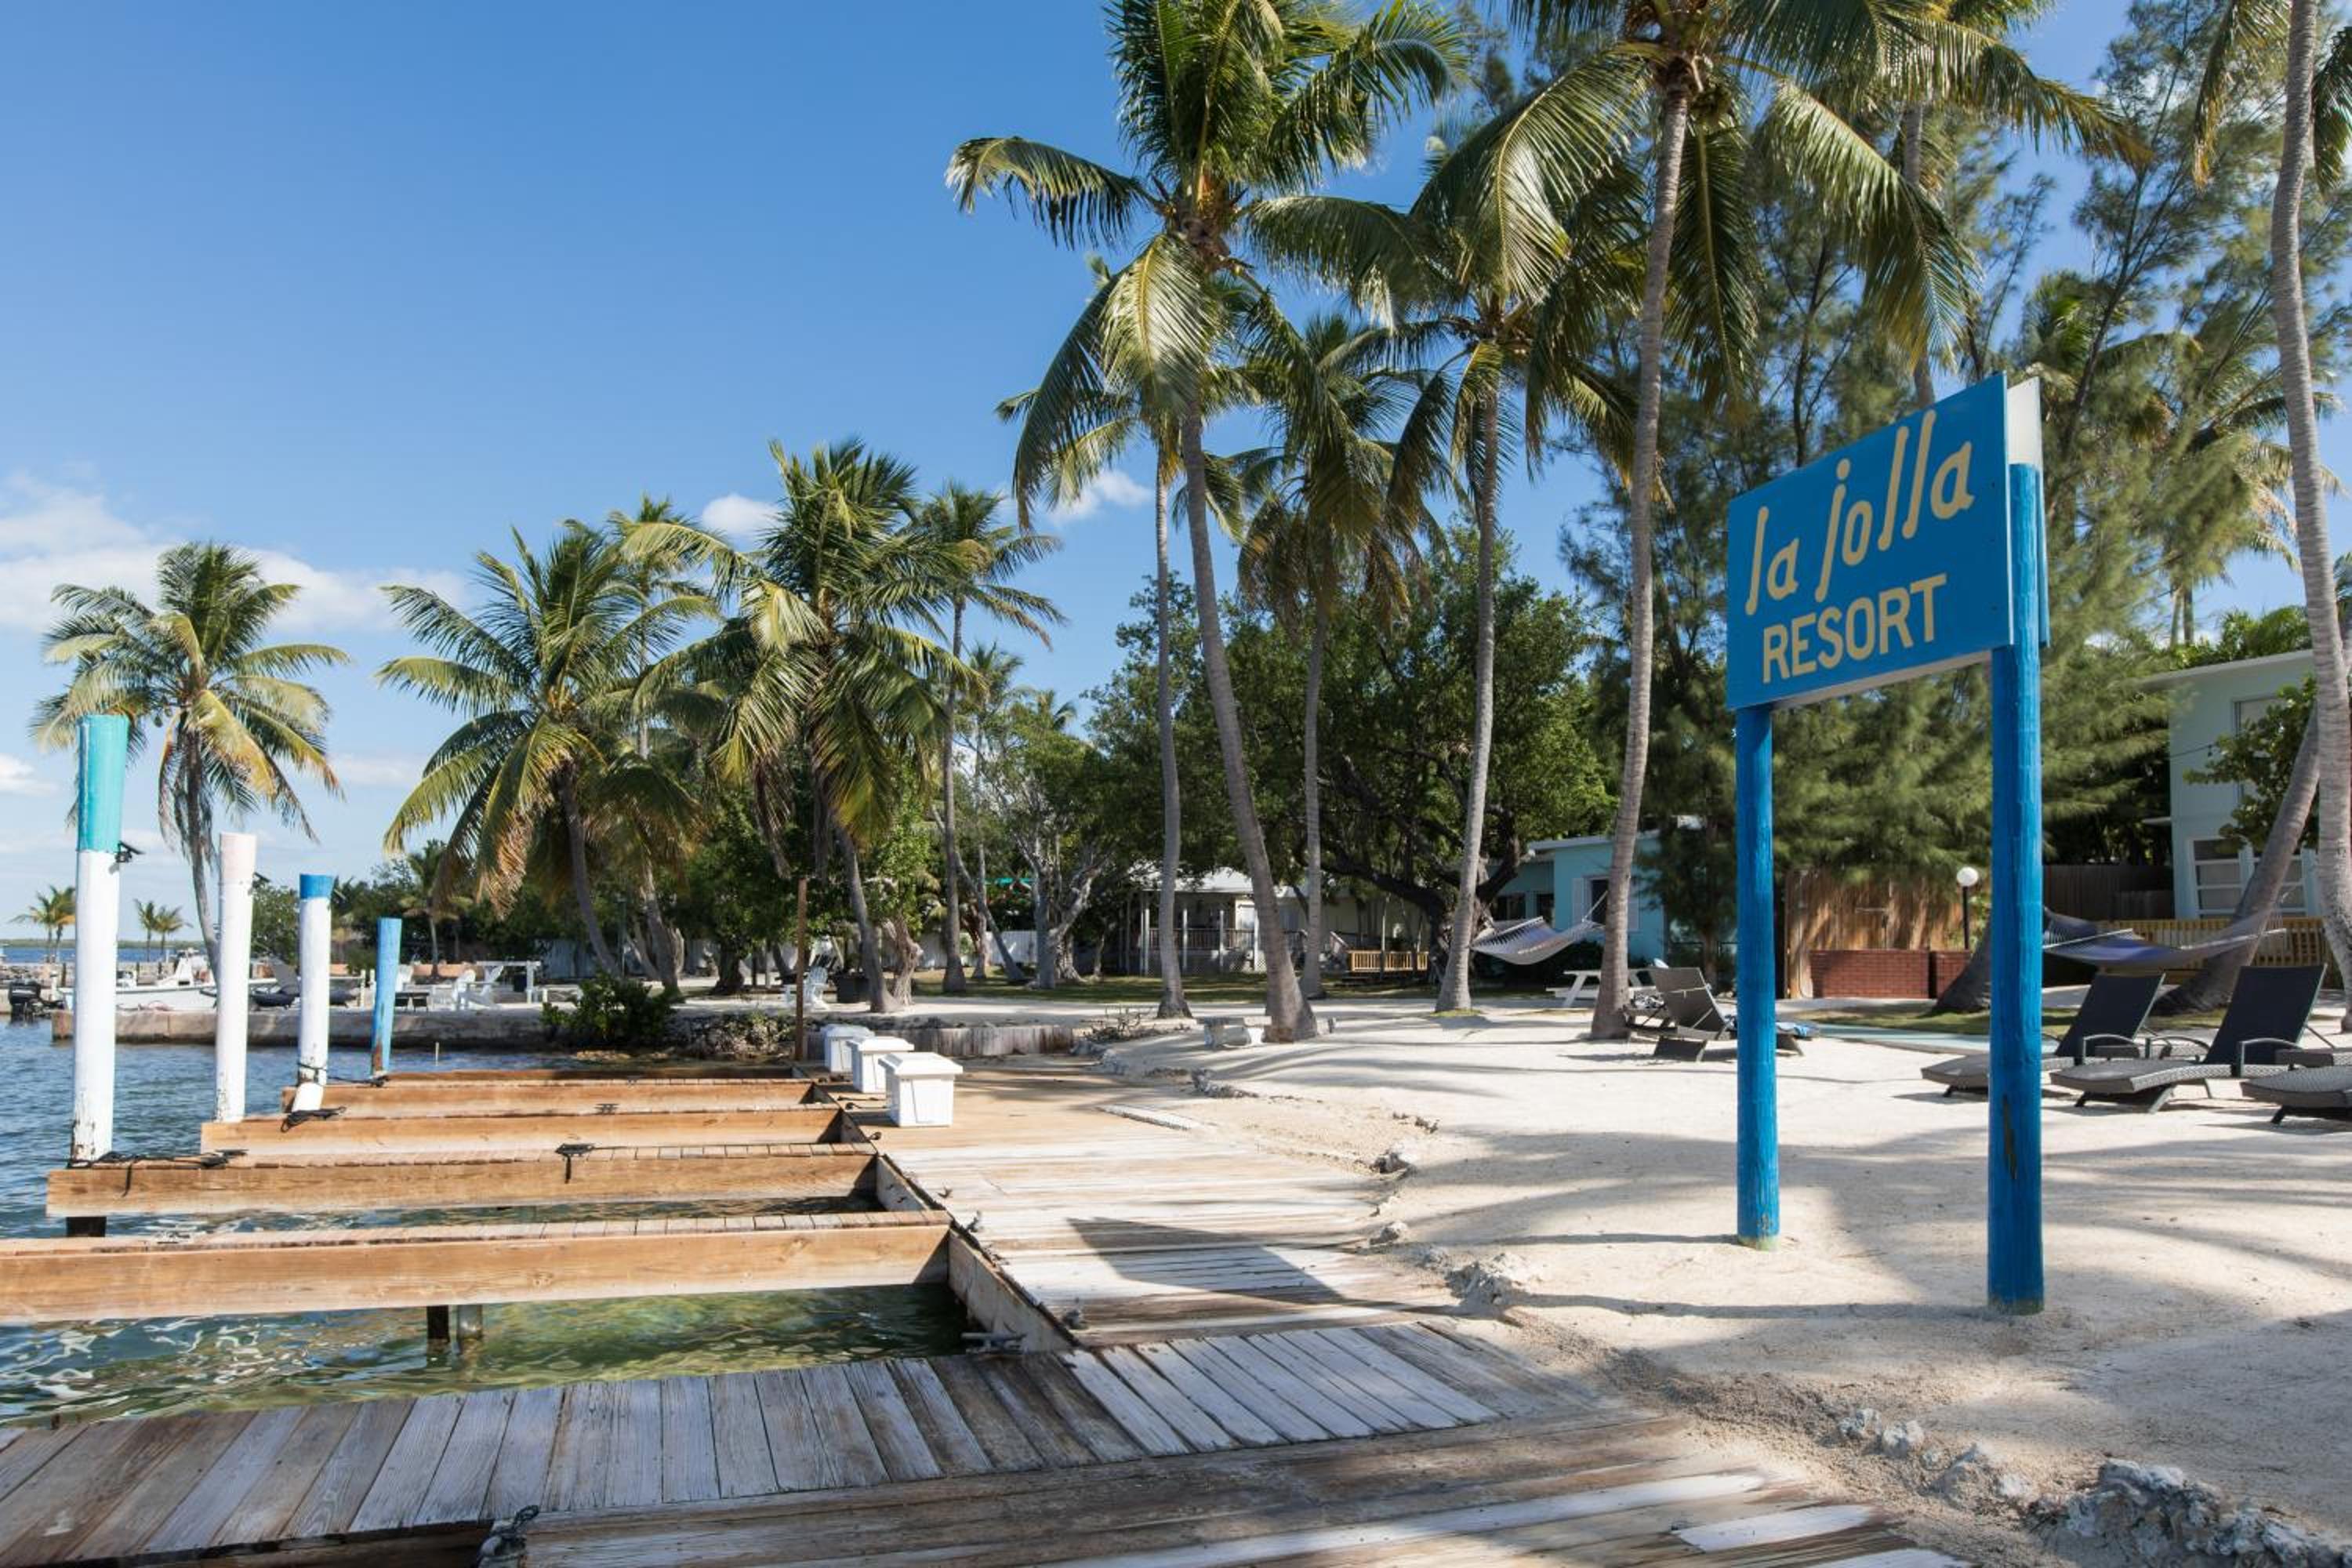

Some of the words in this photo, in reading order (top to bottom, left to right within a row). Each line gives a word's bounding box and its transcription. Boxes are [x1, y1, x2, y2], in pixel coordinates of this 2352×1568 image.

[1745, 506, 1800, 615] la
[1815, 409, 1976, 602] jolla
[1762, 573, 1947, 684] RESORT
